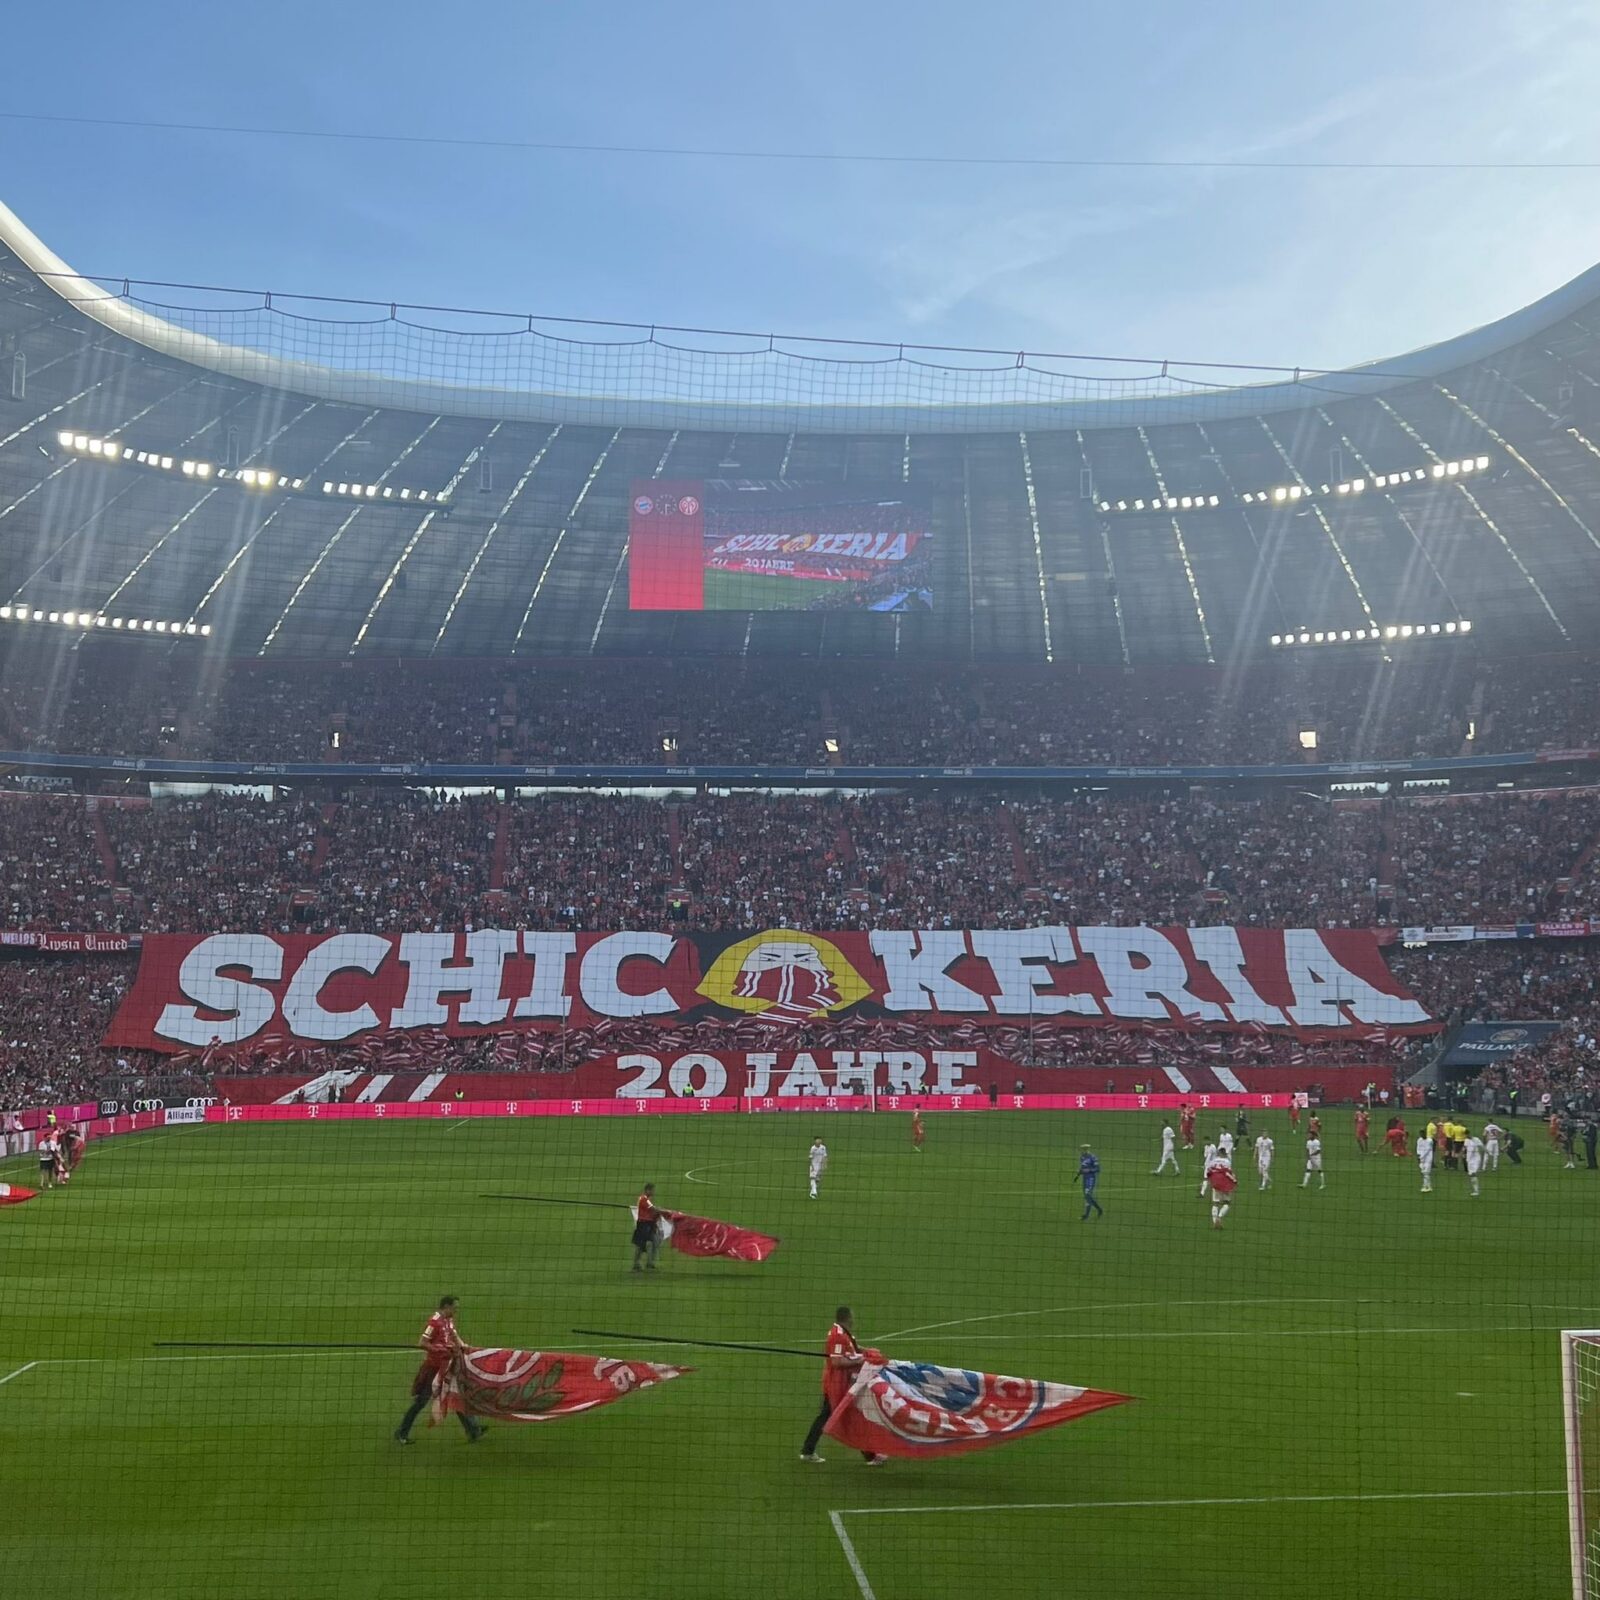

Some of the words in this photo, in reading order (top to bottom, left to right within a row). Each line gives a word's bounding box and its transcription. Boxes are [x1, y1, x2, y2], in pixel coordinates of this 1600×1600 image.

[806, 532, 908, 560] KERIA
[84, 934, 128, 951] United
[868, 926, 1433, 1026] KERIA
[1459, 1042, 1529, 1051] PAULAN
[616, 1053, 728, 1099] 20
[743, 1051, 978, 1098] JAHRE
[167, 1112, 194, 1120] Allianz
